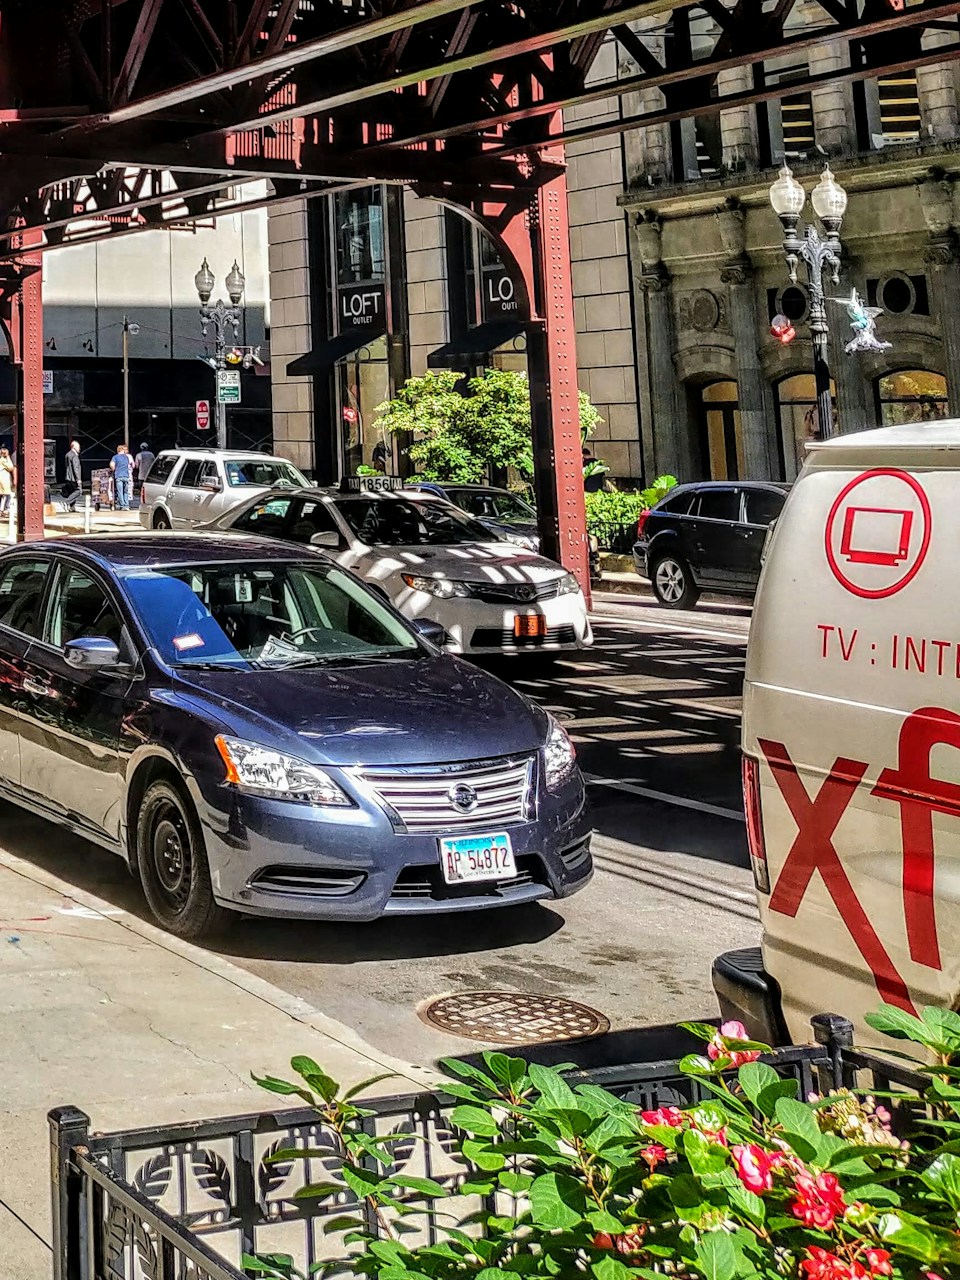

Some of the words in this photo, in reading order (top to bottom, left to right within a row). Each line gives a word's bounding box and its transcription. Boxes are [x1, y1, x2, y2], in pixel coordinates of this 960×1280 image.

[343, 292, 381, 316] LOFT
[353, 316, 373, 325] OUTLET
[360, 478, 389, 491] 1856
[817, 624, 858, 661] TV
[447, 851, 461, 873] AP
[468, 847, 510, 870] 54872
